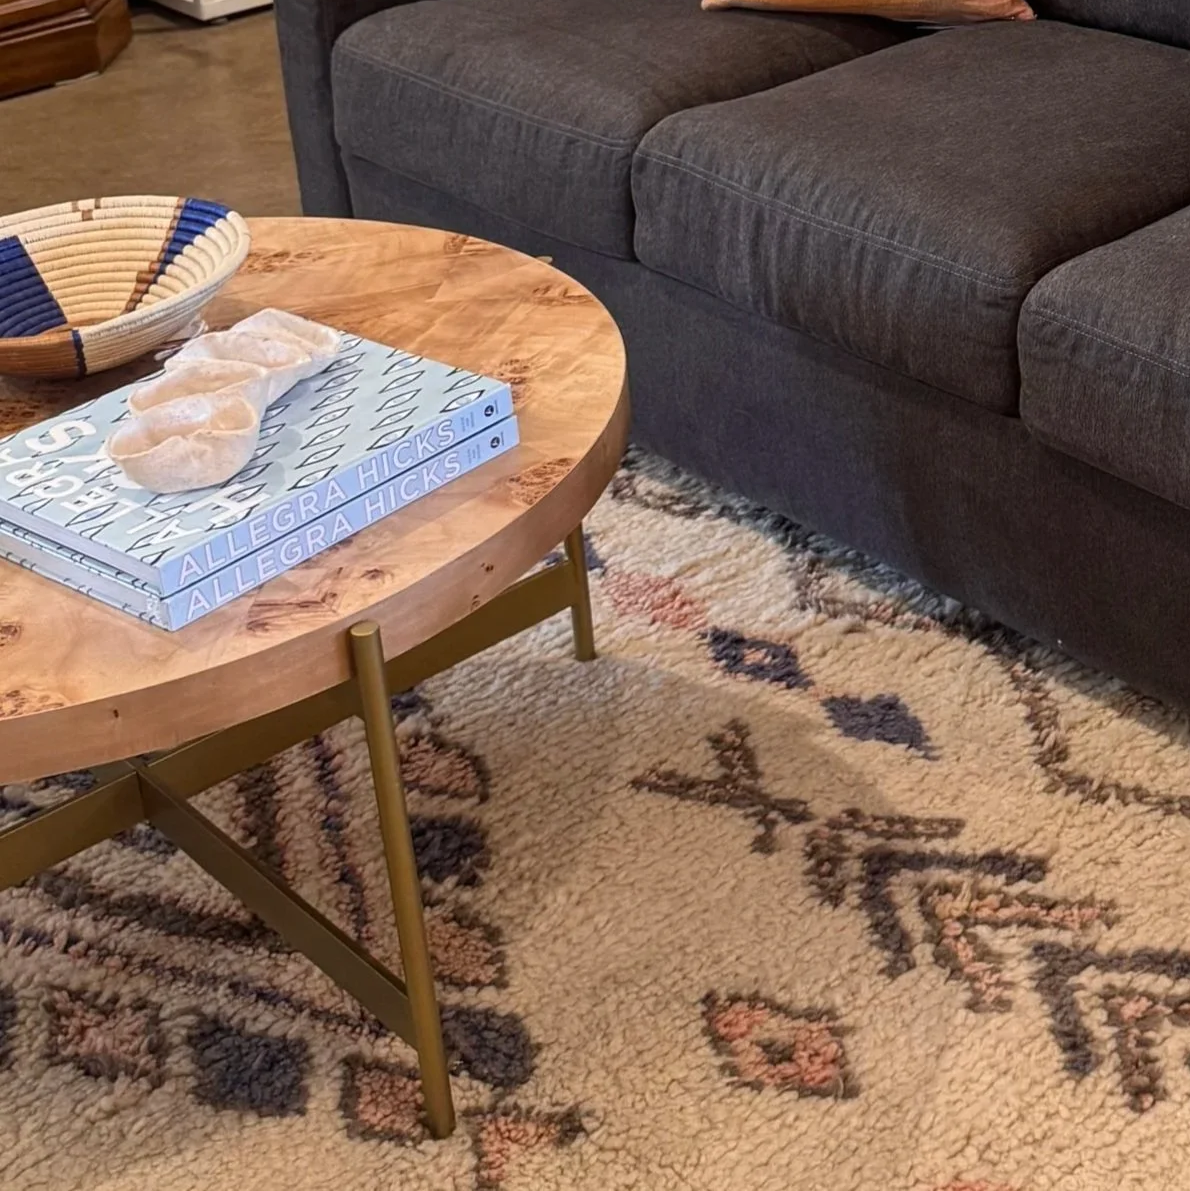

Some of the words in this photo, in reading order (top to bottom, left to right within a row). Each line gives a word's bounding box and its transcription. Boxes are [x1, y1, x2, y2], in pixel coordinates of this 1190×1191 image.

[177, 480, 348, 587] ALLEGRA
[356, 418, 456, 490] HICKS
[184, 514, 354, 622] ALLEGRA
[363, 450, 462, 524] HICKS
